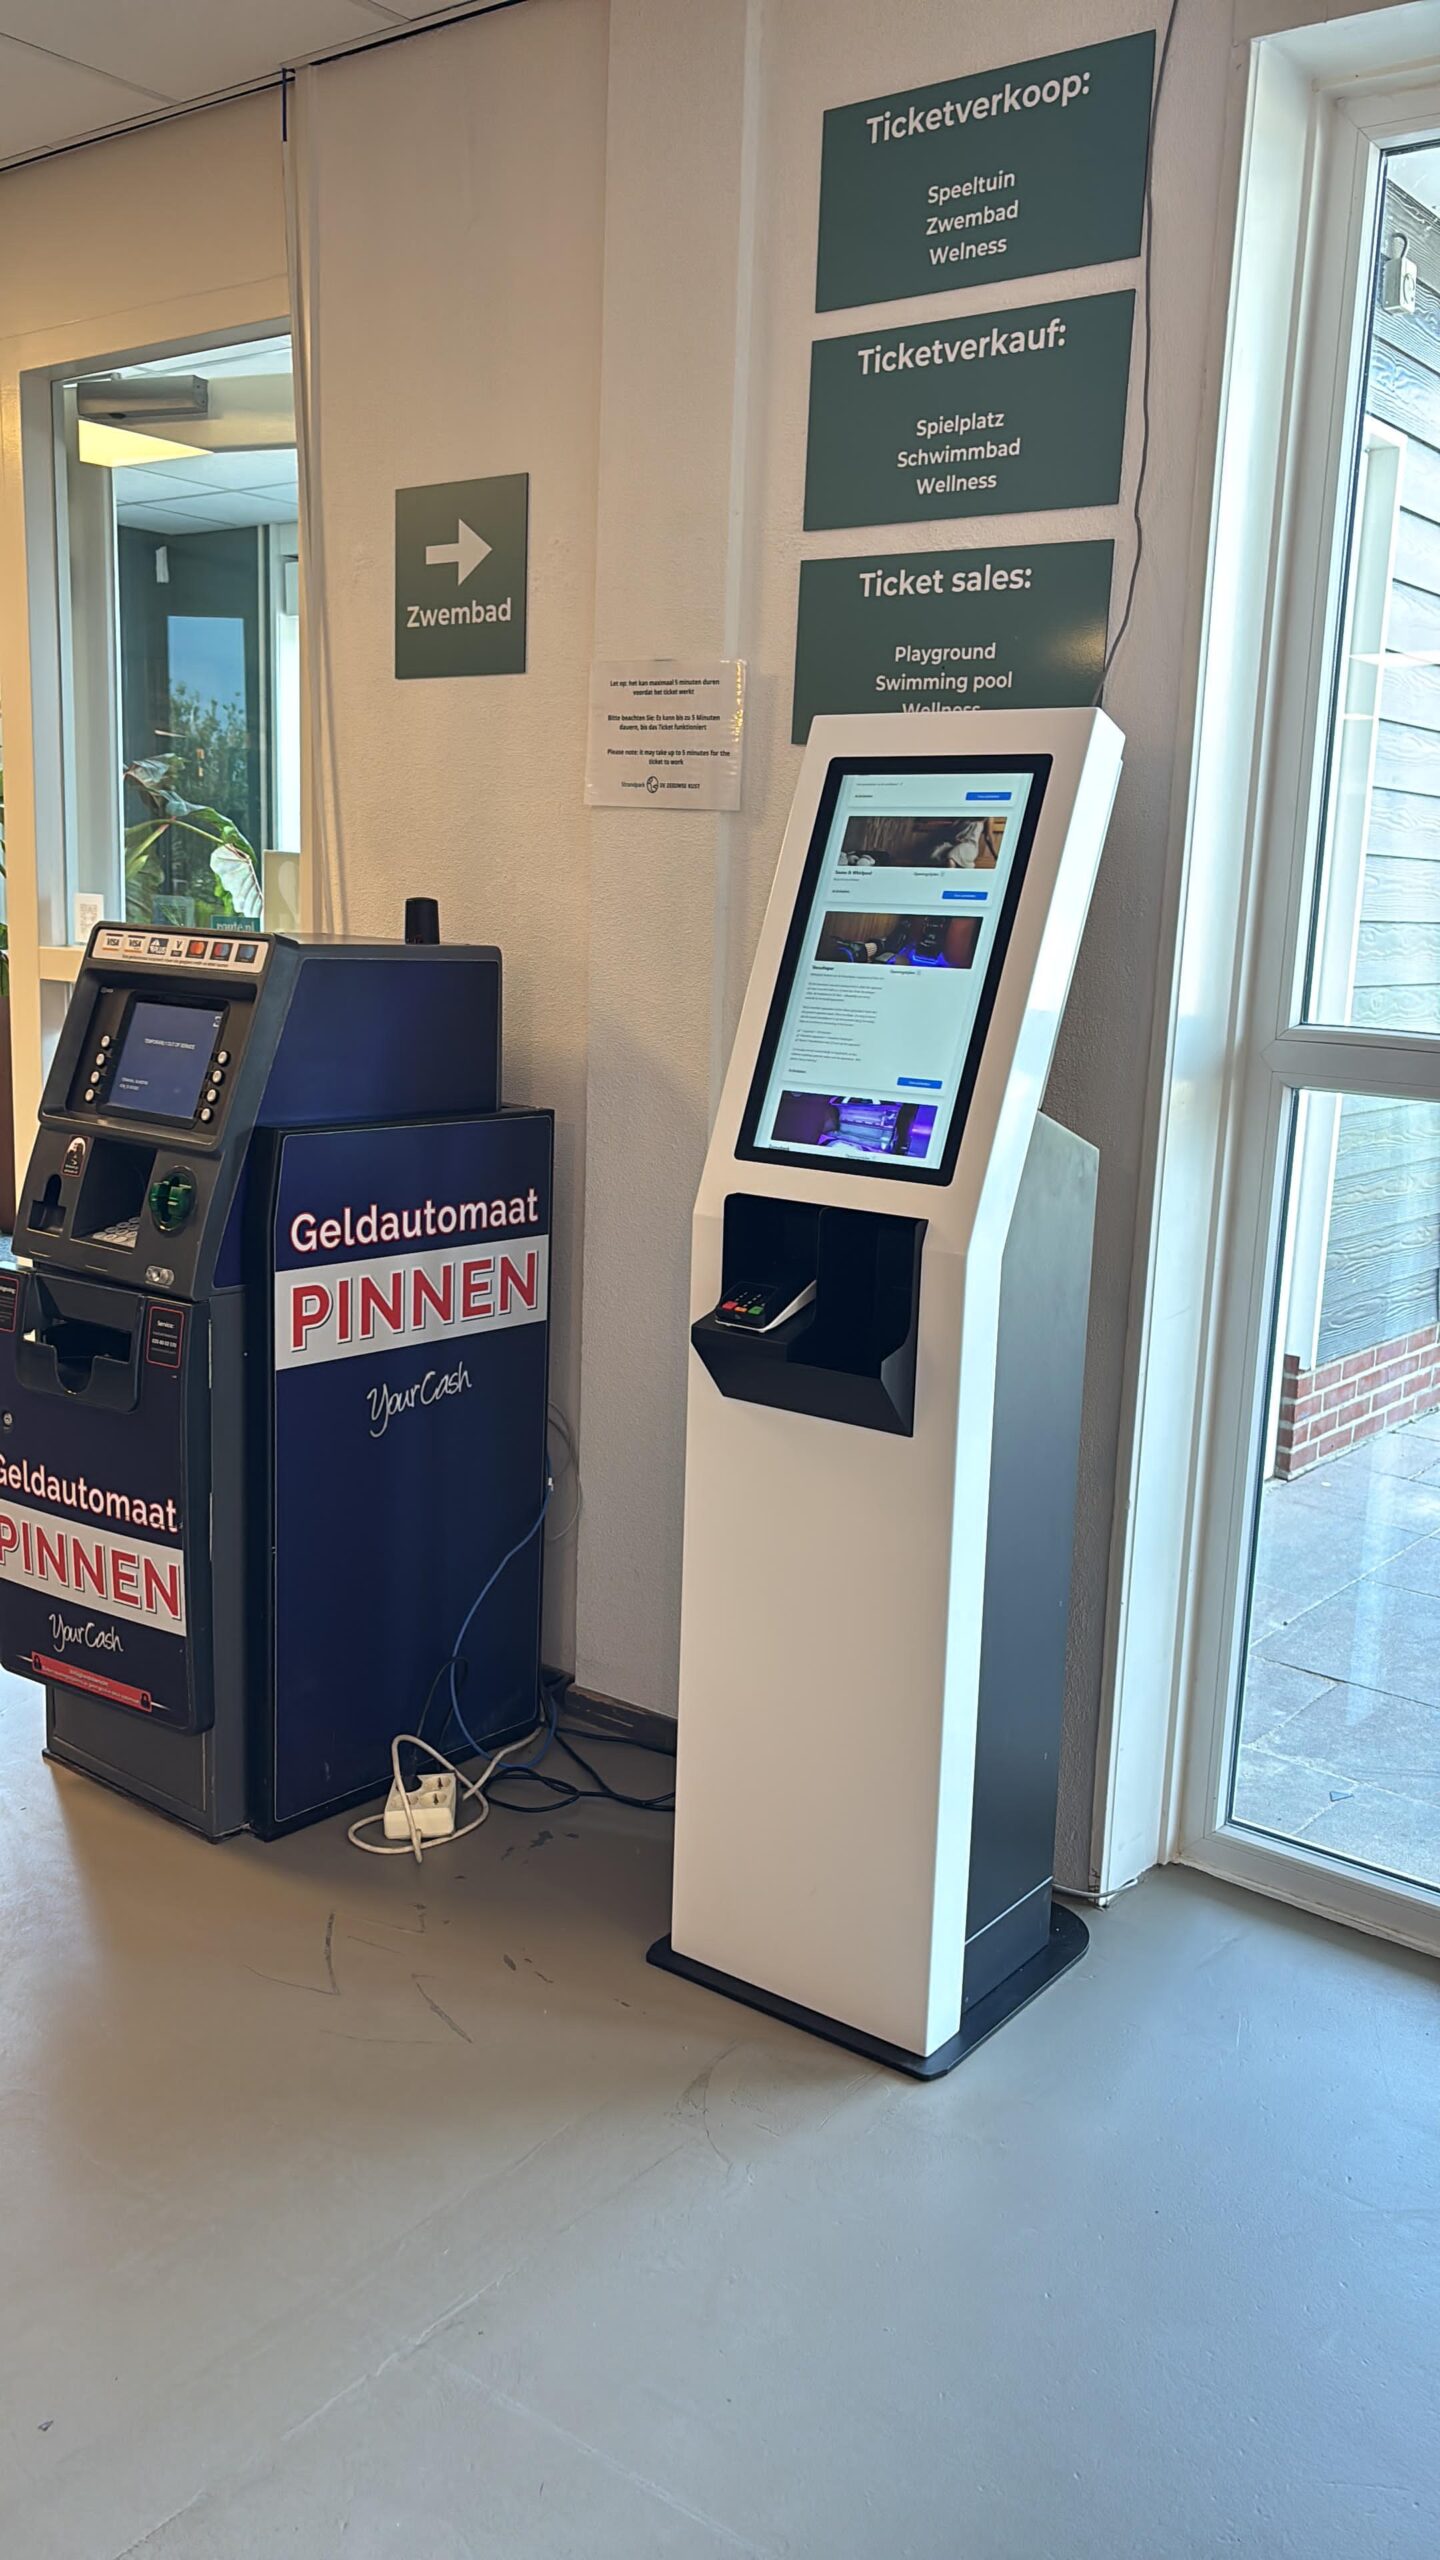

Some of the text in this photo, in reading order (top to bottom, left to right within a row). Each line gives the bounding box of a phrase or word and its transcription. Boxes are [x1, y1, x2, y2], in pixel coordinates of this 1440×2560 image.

[866, 72, 1091, 144] Ticketverkoop:
[927, 170, 1015, 205] Speeltuin
[926, 200, 1019, 235] Zwembad
[929, 238, 1007, 265] Welness
[857, 318, 1066, 375] Ticketverkauf:
[916, 411, 1005, 439] Spielplatz
[896, 437, 1021, 468] Schwimmbad
[916, 474, 997, 495] Wellness
[859, 564, 1032, 598] Ticket sales:
[406, 597, 511, 627] Zwembad
[894, 642, 996, 665] Playground
[875, 671, 1012, 693] Swimming pool
[674, 723, 707, 731] funktioniert
[107, 937, 120, 946] VISA
[129, 939, 142, 947] VISA
[290, 1188, 539, 1251] Geldautomaat
[290, 1250, 538, 1352] PINNEN
[0, 1514, 182, 1620] PINNEN
